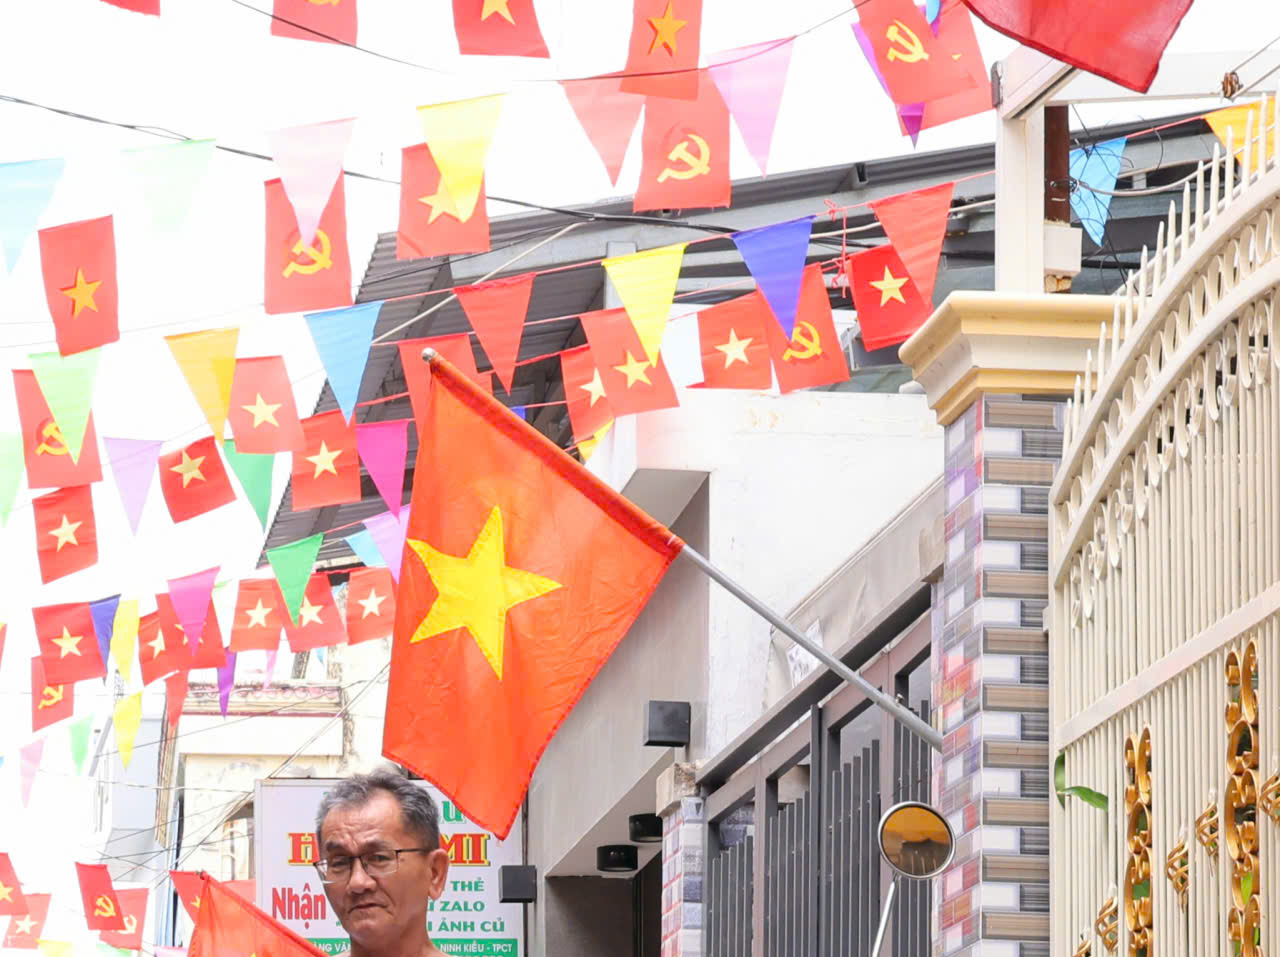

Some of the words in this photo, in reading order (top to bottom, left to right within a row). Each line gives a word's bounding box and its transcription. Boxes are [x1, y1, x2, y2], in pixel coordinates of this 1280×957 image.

[271, 882, 327, 930] Nhận
[439, 900, 485, 912] ZALO
[440, 943, 462, 953] NINH
[492, 943, 513, 953] TPCT
